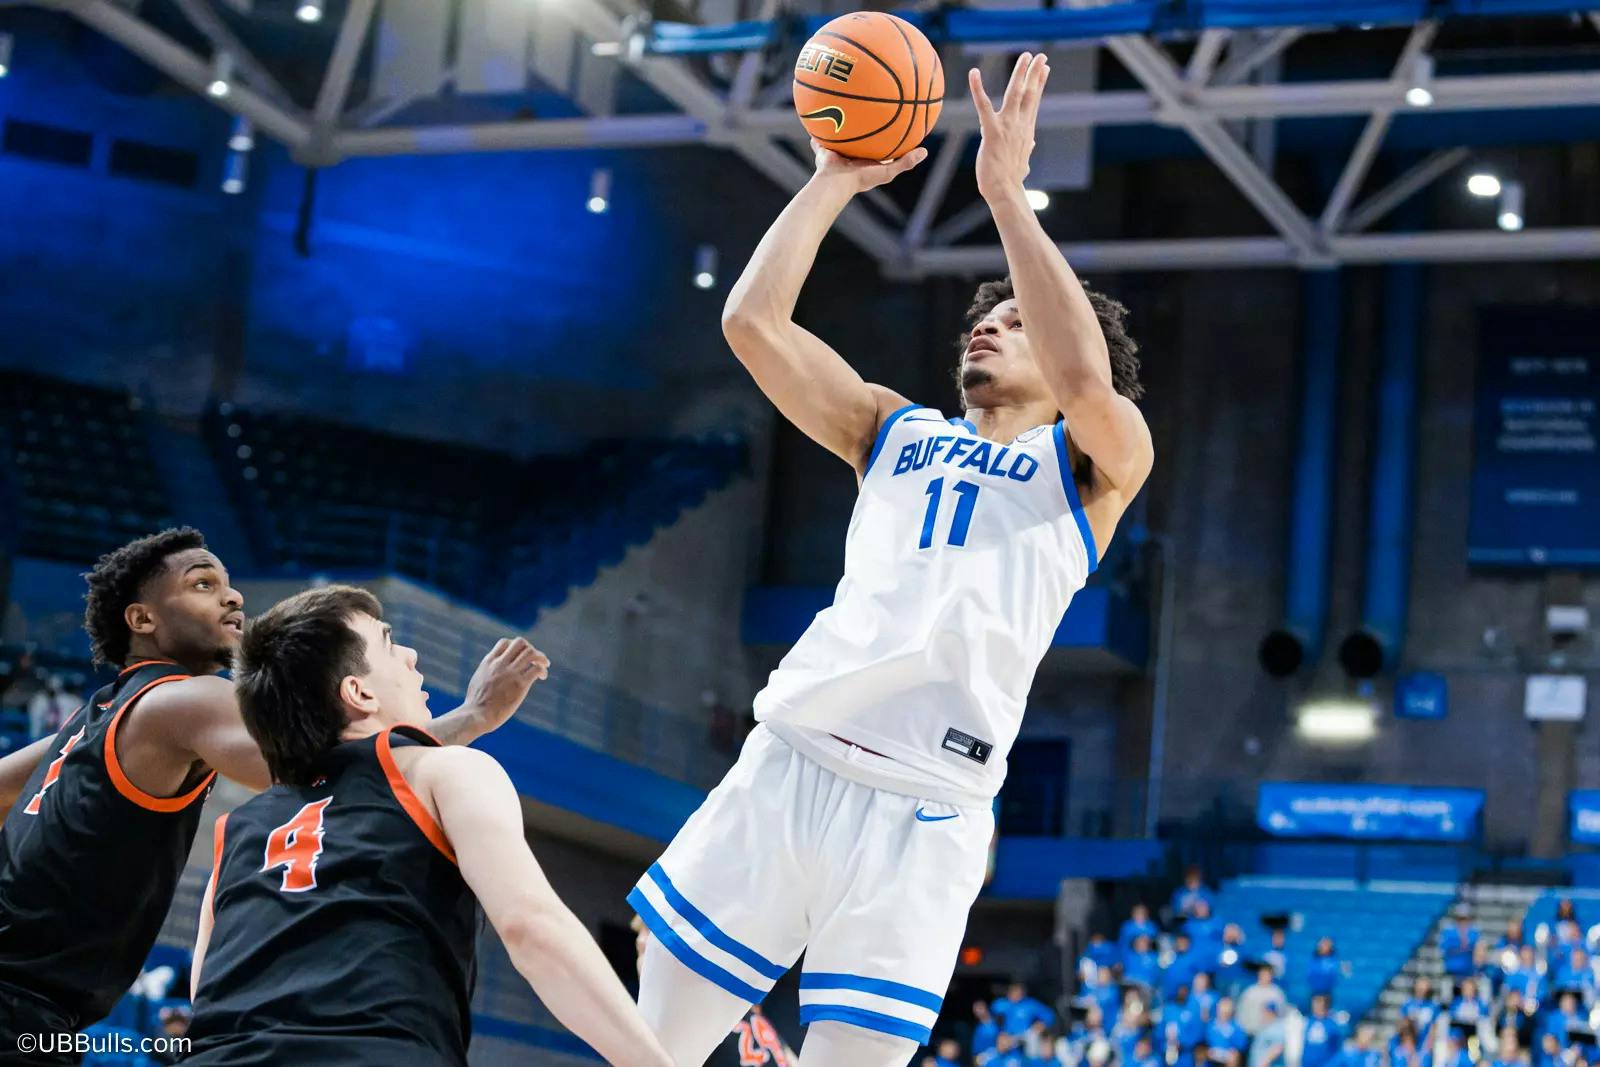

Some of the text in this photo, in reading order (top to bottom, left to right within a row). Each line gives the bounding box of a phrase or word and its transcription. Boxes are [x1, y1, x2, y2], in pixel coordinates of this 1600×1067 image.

[892, 436, 1039, 482] BUFFALO
[918, 476, 981, 550] 11
[975, 745, 982, 757] L
[258, 795, 334, 892] 4
